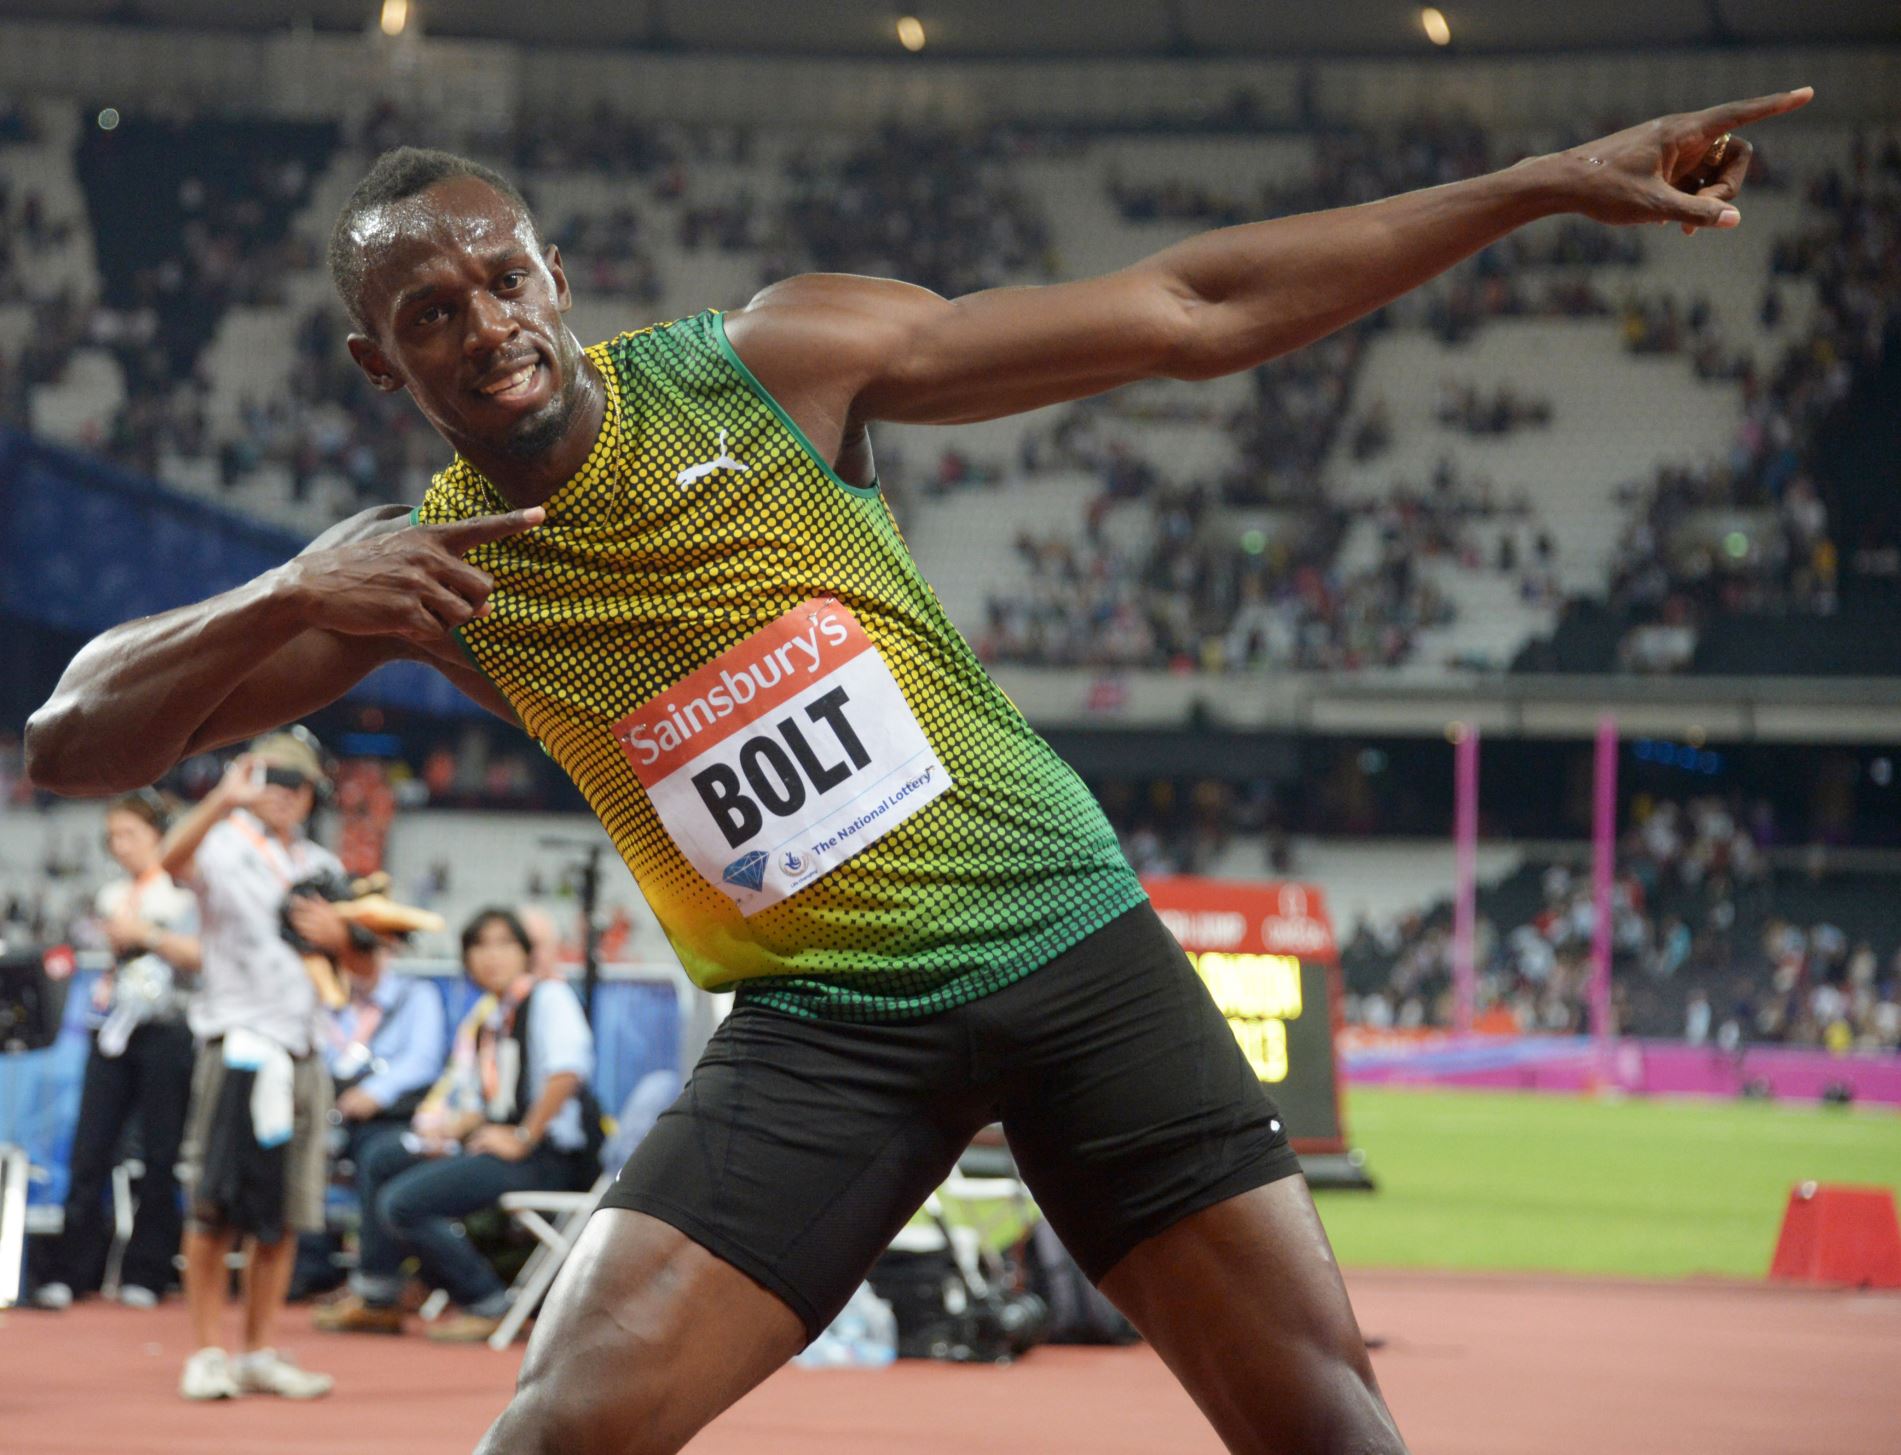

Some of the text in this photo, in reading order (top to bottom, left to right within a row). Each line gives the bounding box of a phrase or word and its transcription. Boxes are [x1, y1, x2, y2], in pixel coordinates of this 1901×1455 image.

[630, 612, 848, 765] Sainsbury's
[691, 685, 872, 850] BOLT
[812, 769, 931, 856] The National Lottery
